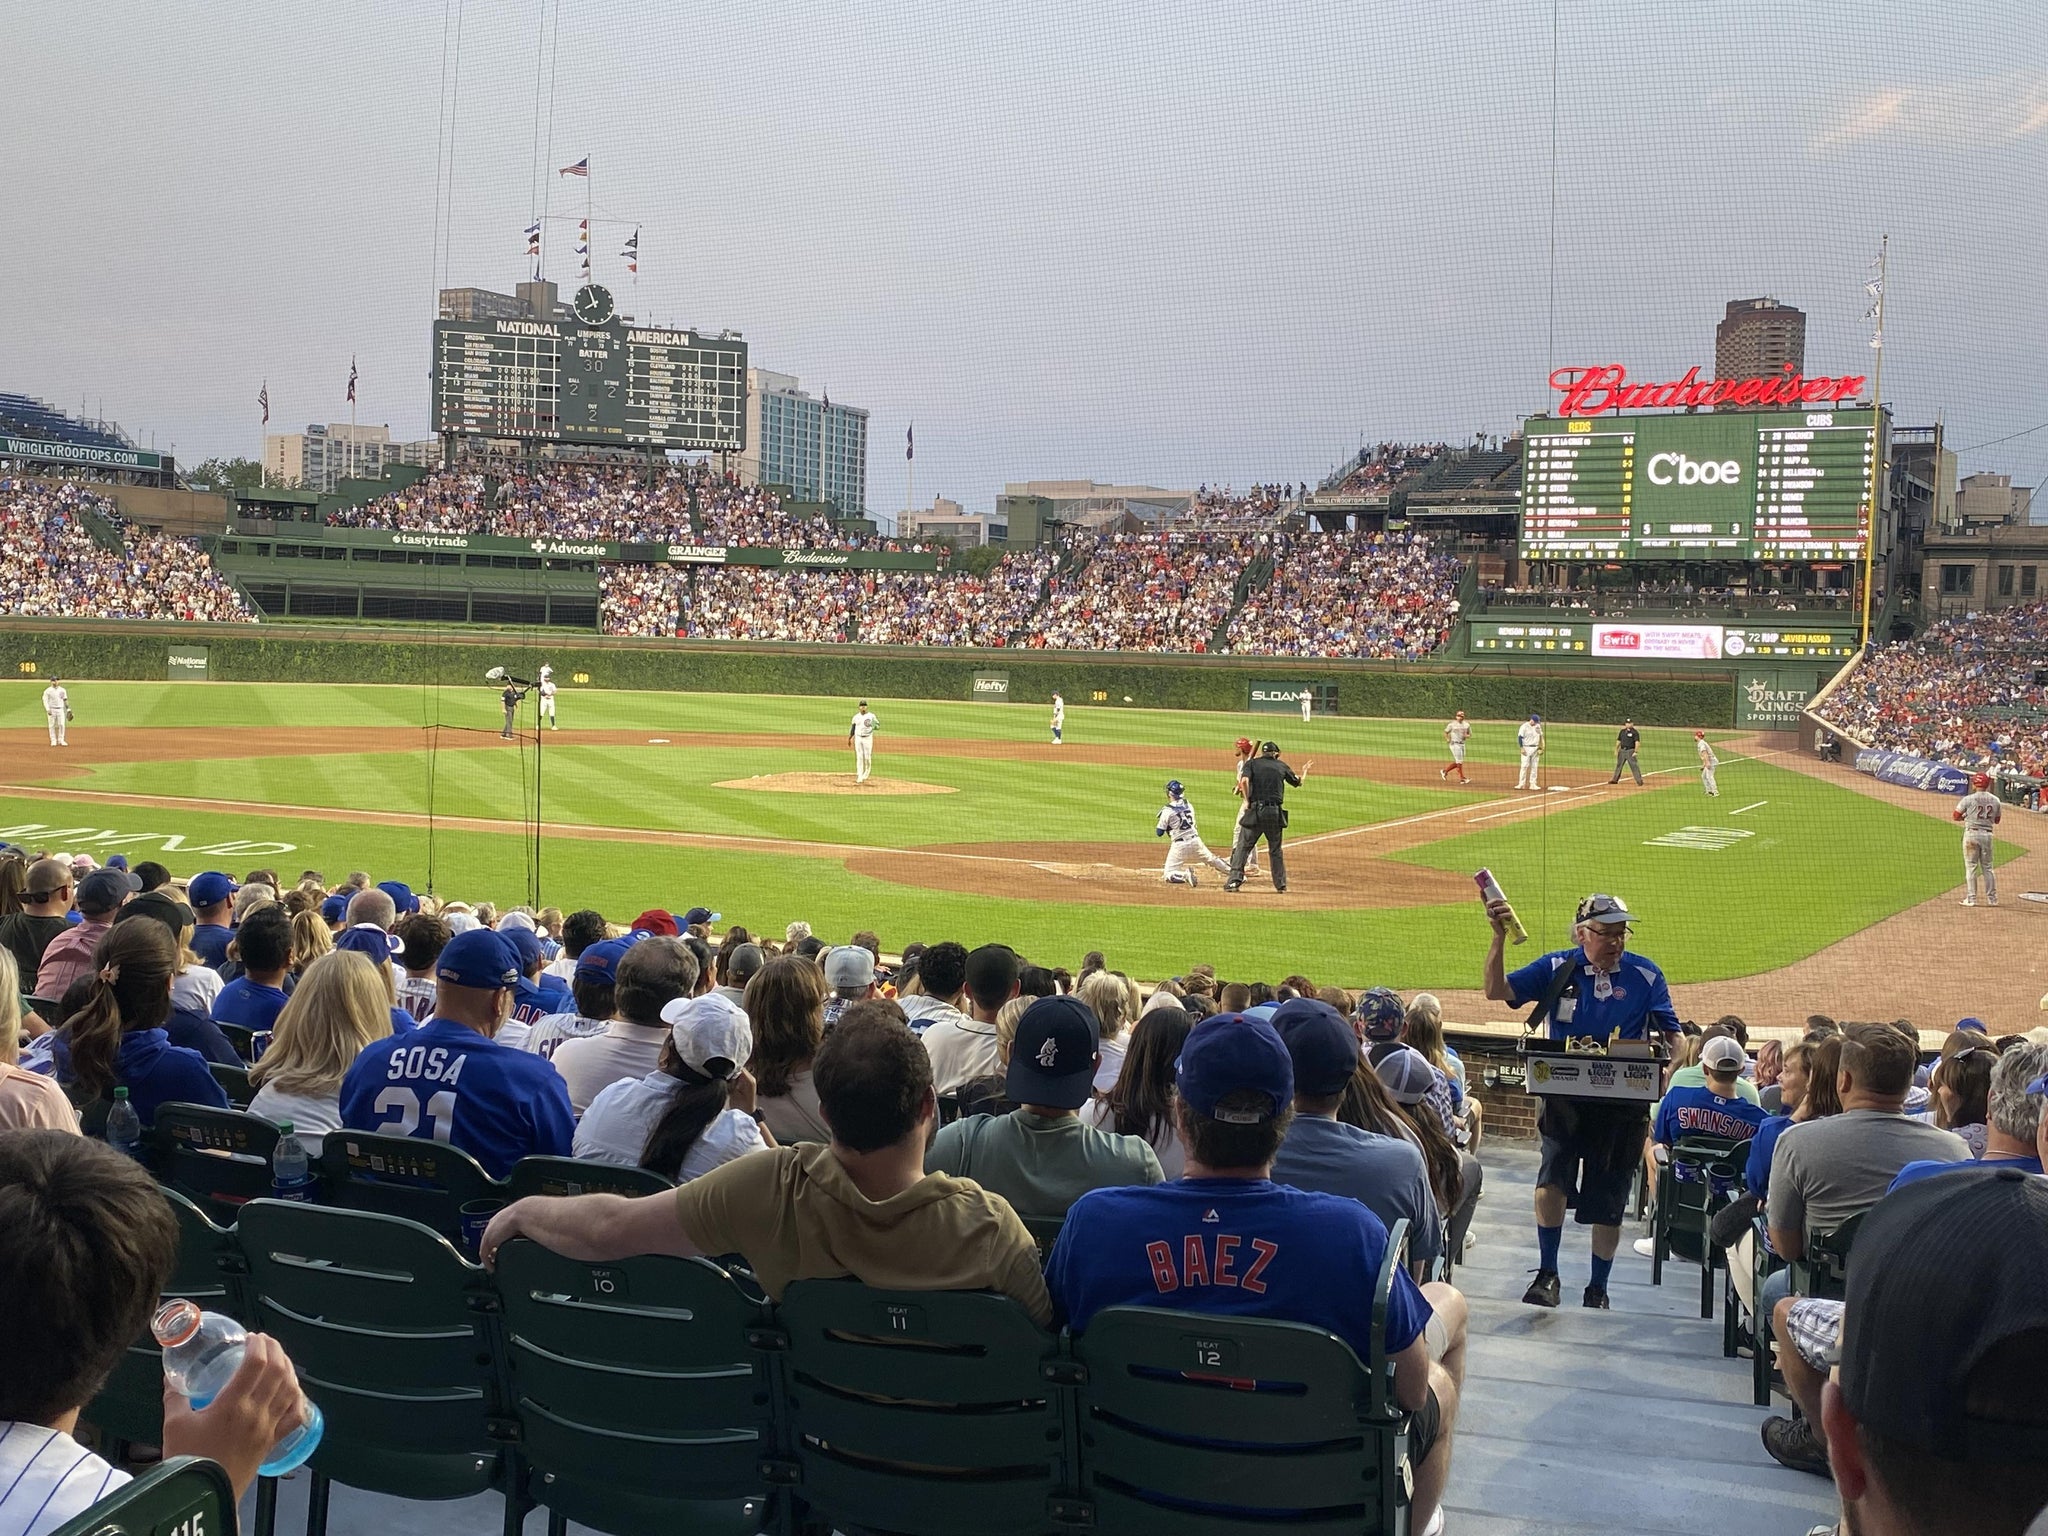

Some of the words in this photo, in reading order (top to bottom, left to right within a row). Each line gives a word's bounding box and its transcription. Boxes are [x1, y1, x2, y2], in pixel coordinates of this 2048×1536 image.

[496, 321, 561, 336] NATIONAL
[577, 330, 610, 339] UMPIRES
[626, 330, 688, 346] AMERICAN
[579, 350, 608, 359] BATTER
[584, 360, 602, 372] 30
[570, 384, 578, 395] 2
[608, 386, 616, 398] 2
[1549, 362, 1866, 416] Budweiser
[589, 410, 597, 421] 2
[1806, 414, 1832, 426] CUBS
[1569, 421, 1591, 432] REDS
[8, 440, 137, 464] WRIGLEYROOFTOPS.COM
[1648, 452, 1740, 485] Cboe
[1758, 481, 1762, 489] 7
[1770, 481, 1779, 489] SS
[1643, 524, 1650, 535] 5
[1732, 523, 1739, 534] 3
[402, 534, 468, 547] tastytrade
[549, 542, 606, 555] Advocate
[668, 546, 727, 556] GRAINGER
[782, 551, 848, 564] Budweiser
[1529, 628, 1553, 636] SEASON
[1748, 633, 1760, 642] 72
[1762, 633, 1779, 642] RHP
[1781, 634, 1806, 643] JAVIER
[1808, 635, 1830, 643] ASSAD
[1490, 640, 1495, 648] 9
[1519, 641, 1524, 649] 4
[1604, 635, 1634, 645] Swift
[20, 662, 35, 672] 368
[573, 674, 588, 683] 400
[976, 681, 1005, 691] Hefty
[1748, 690, 1807, 702] DRAFT
[1755, 701, 1805, 712] KINGS
[1977, 805, 1993, 819] 22
[387, 1046, 467, 1085] SOSA
[1500, 1066, 1510, 1074] BE
[1511, 1067, 1525, 1075] ALE
[1588, 1069, 1617, 1077] LIGHT
[1624, 1071, 1653, 1079] LIGHT
[374, 1086, 457, 1144] 21
[1678, 1107, 1756, 1139] SWANSON
[1146, 1234, 1278, 1294] BAEZ
[594, 1279, 614, 1292] 10
[888, 1307, 908, 1315] SEAT
[892, 1316, 906, 1330] 11
[1197, 1341, 1219, 1349] SEAT
[1199, 1351, 1221, 1366] 12
